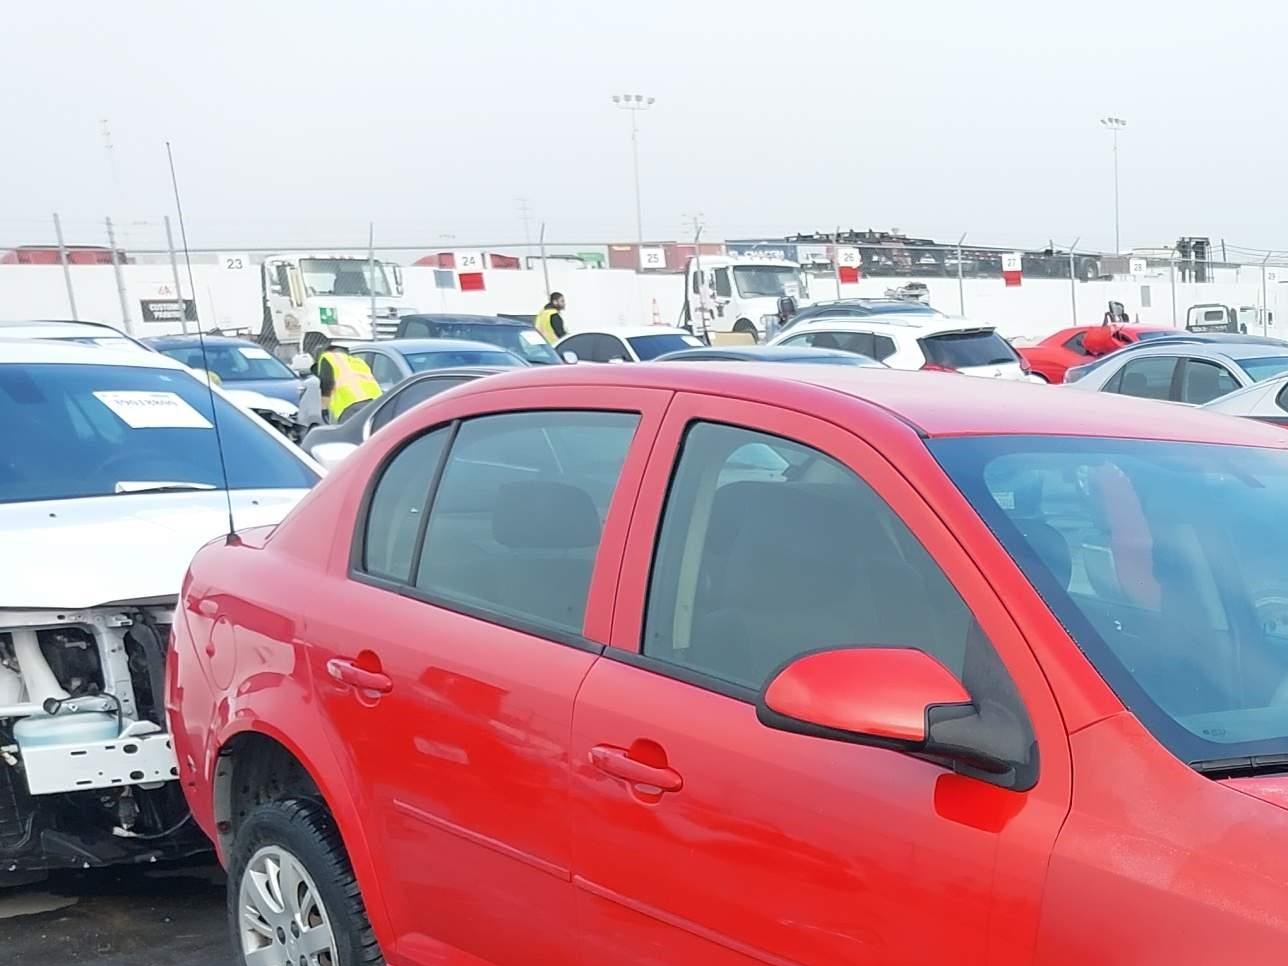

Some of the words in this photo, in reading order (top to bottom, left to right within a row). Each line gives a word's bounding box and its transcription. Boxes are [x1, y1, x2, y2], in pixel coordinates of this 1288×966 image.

[462, 256, 476, 267] 24
[646, 253, 660, 264] 25
[843, 253, 855, 262] 26
[1007, 258, 1017, 267] 27
[226, 258, 244, 270] 23
